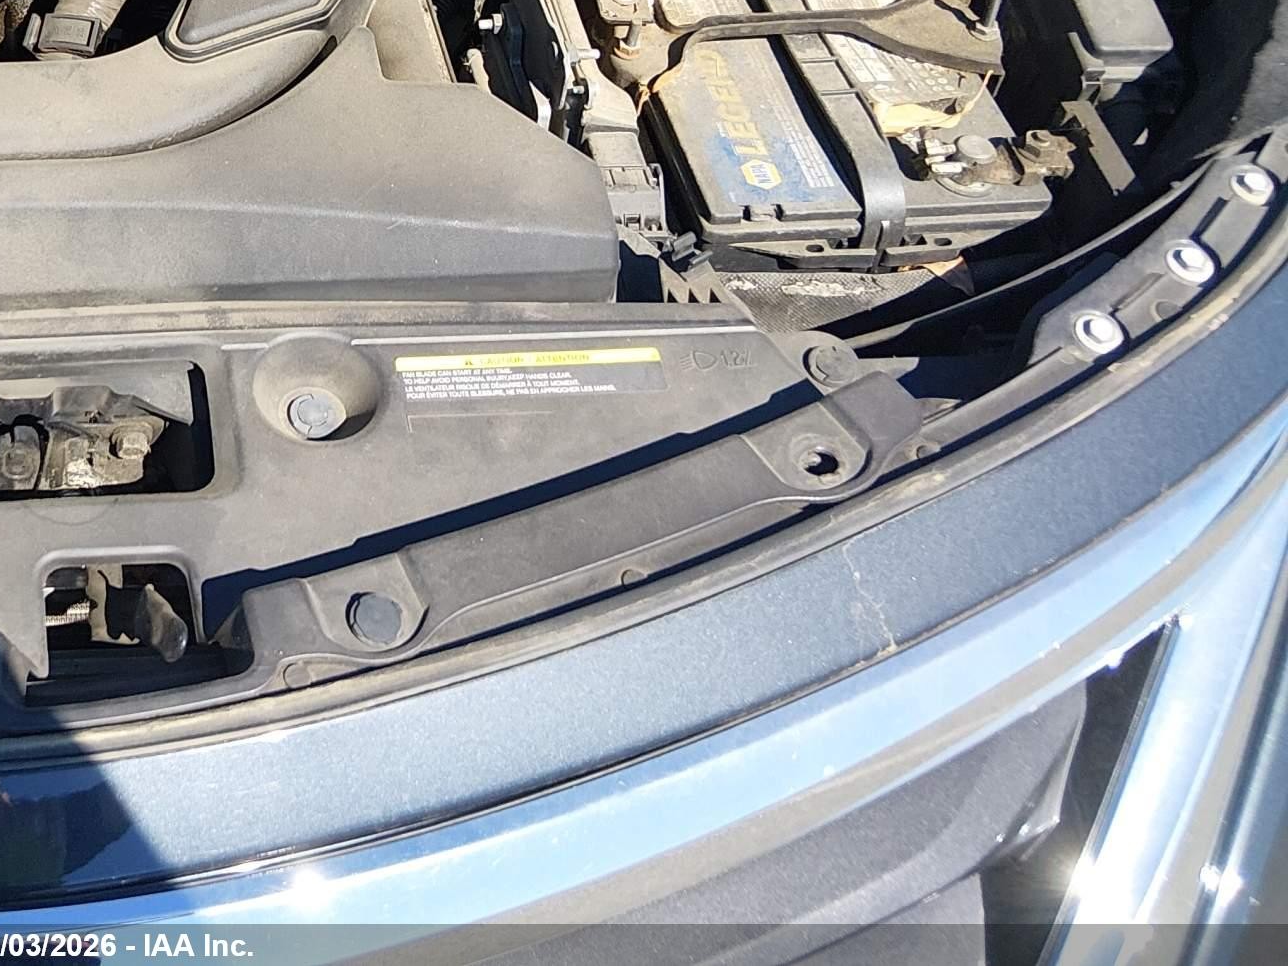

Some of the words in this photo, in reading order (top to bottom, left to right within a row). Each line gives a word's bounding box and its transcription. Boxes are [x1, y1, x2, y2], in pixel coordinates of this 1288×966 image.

[750, 164, 773, 185] NAPA
[431, 376, 451, 384] AVOID
[452, 375, 486, 383] PERSONAL
[525, 372, 549, 380] HANDS
[414, 384, 455, 392] VENTILATEUR
[449, 390, 470, 398] TOUTE
[540, 385, 581, 394] APPROCHER
